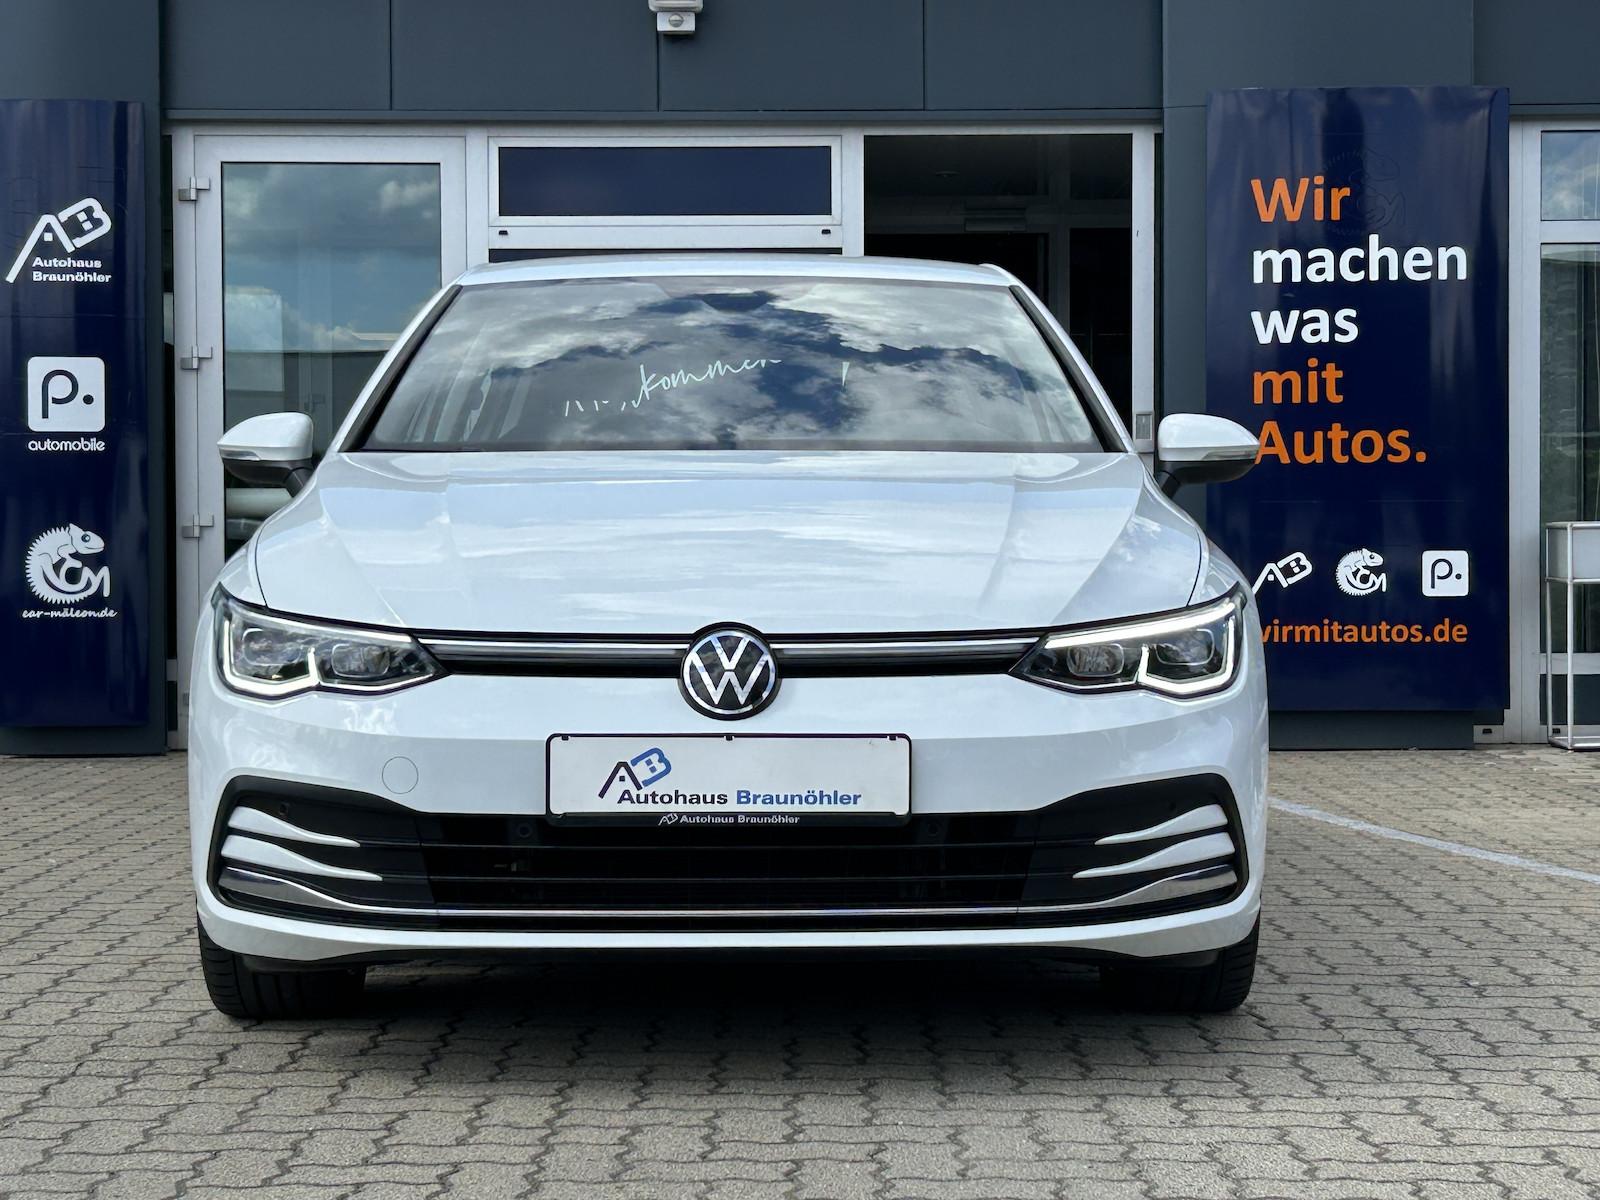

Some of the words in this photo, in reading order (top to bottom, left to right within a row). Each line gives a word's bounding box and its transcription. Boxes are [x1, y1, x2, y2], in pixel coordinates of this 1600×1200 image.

[1251, 175, 1351, 223] Wir
[32, 257, 103, 268] Autohaus
[1253, 233, 1468, 284] machen
[32, 270, 112, 283] Braunöhler
[1250, 308, 1359, 345] was
[1253, 357, 1344, 404] mit
[28, 437, 105, 452] automobile
[1254, 420, 1427, 465] Autos.
[617, 789, 728, 805] Autohaus
[736, 789, 862, 805] Braunöhler
[680, 814, 735, 824] Autohaus
[737, 814, 801, 824] Braunöhler
